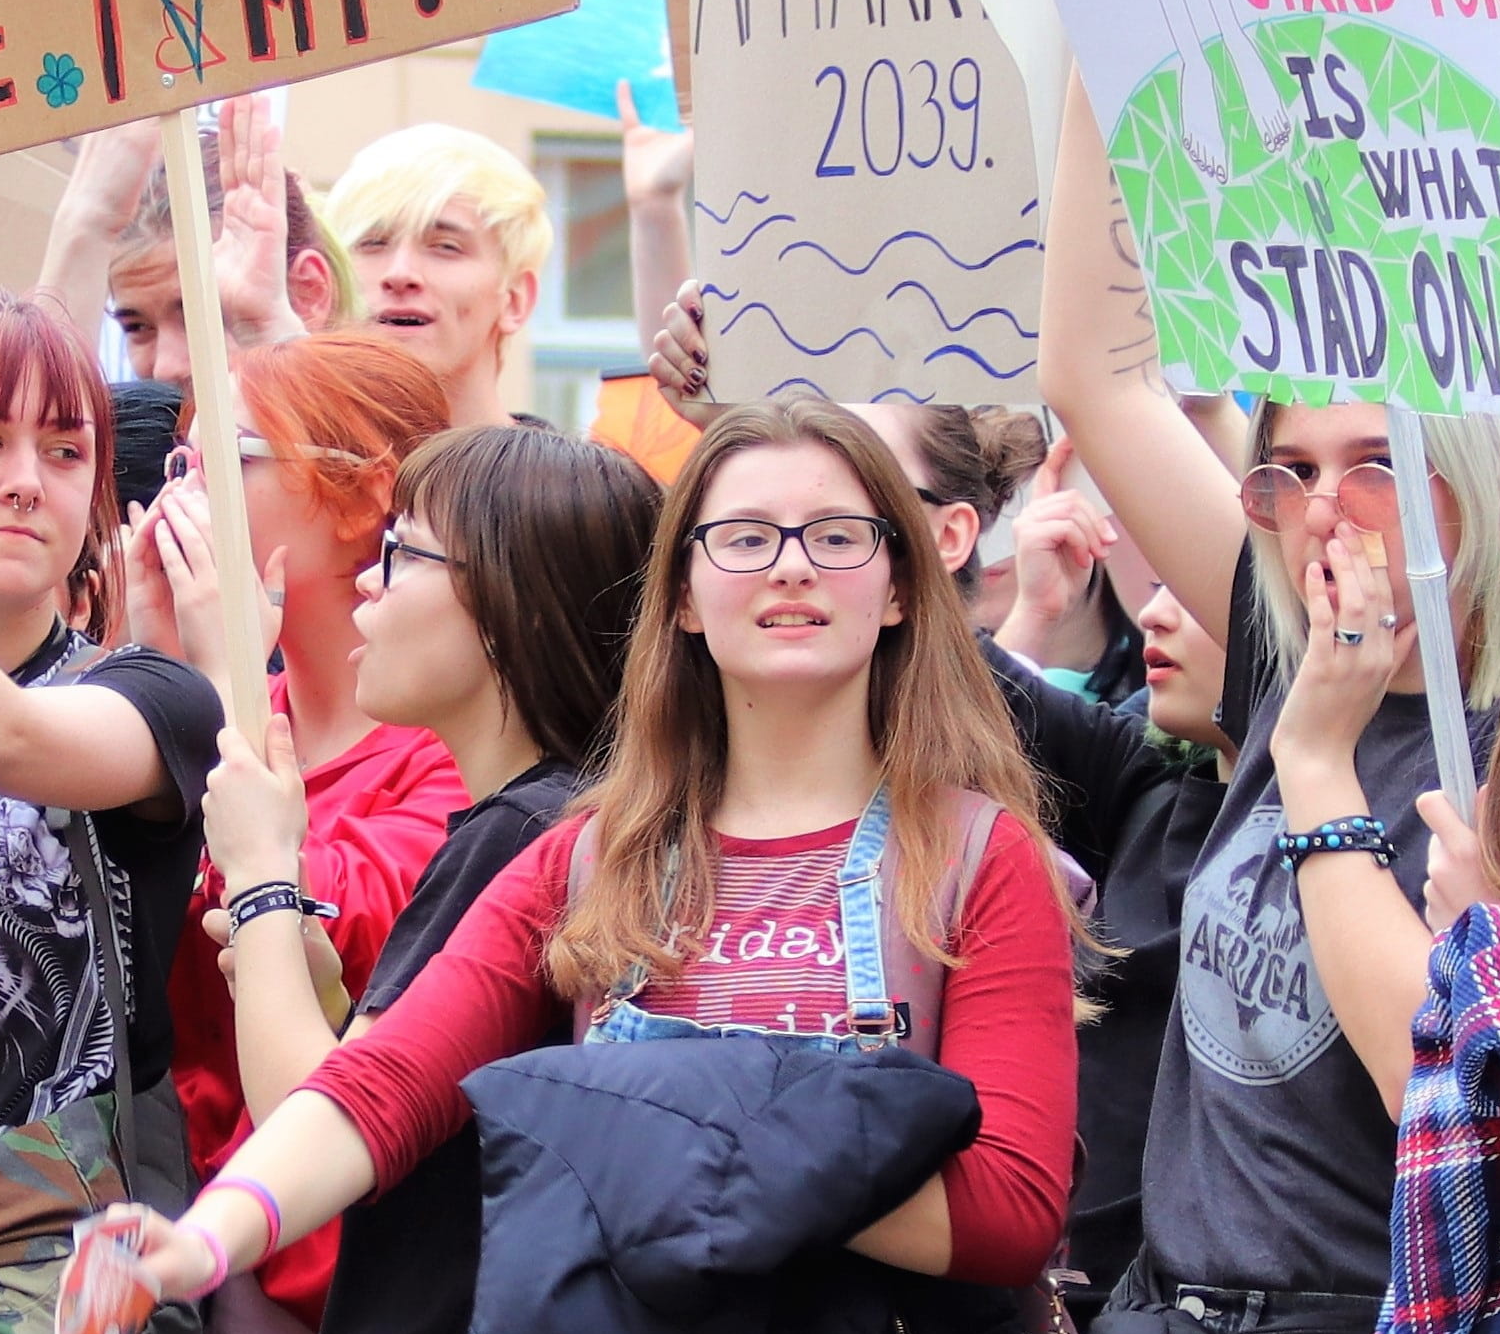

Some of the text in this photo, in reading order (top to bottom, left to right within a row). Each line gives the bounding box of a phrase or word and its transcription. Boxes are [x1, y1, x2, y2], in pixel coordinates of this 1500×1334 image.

[815, 57, 997, 178] 2039.
[1286, 52, 1368, 141] IS
[1186, 912, 1312, 1023] AFRICA
